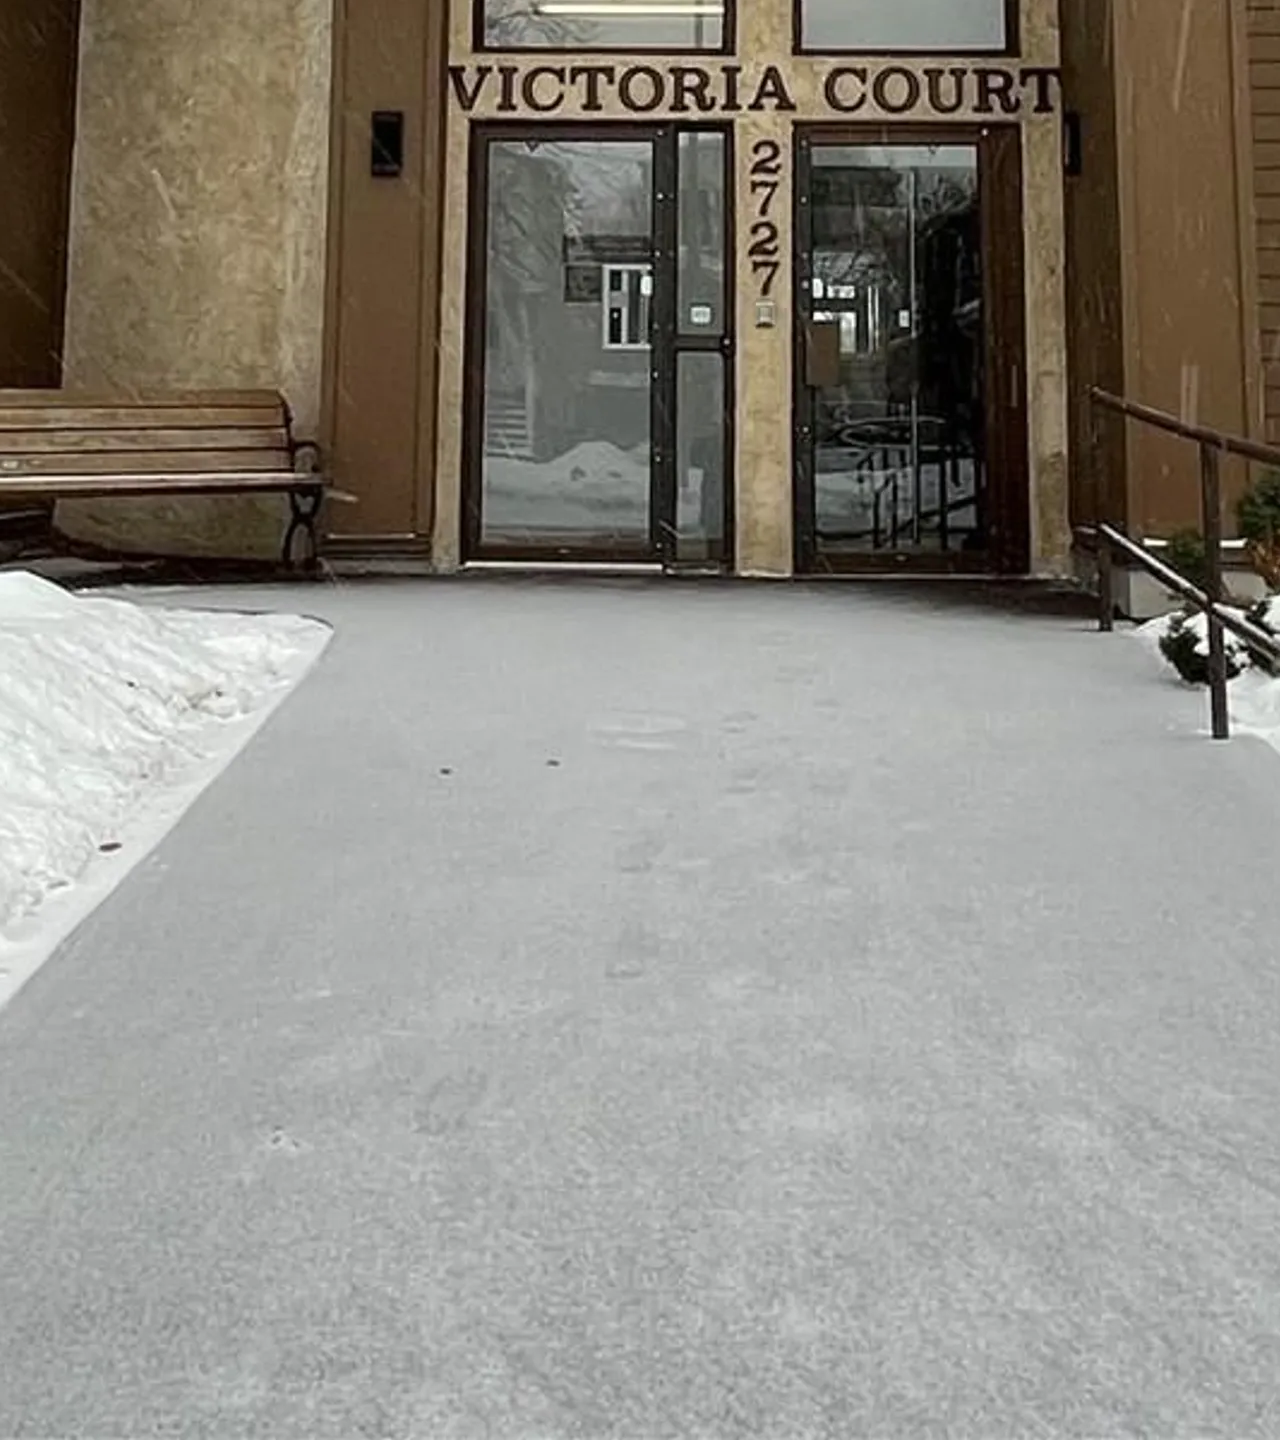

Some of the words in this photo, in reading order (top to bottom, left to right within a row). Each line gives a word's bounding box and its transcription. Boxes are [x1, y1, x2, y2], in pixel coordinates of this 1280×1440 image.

[449, 65, 797, 113] VICTORIA
[824, 66, 1062, 114] COURT
[750, 139, 781, 297] 2727
